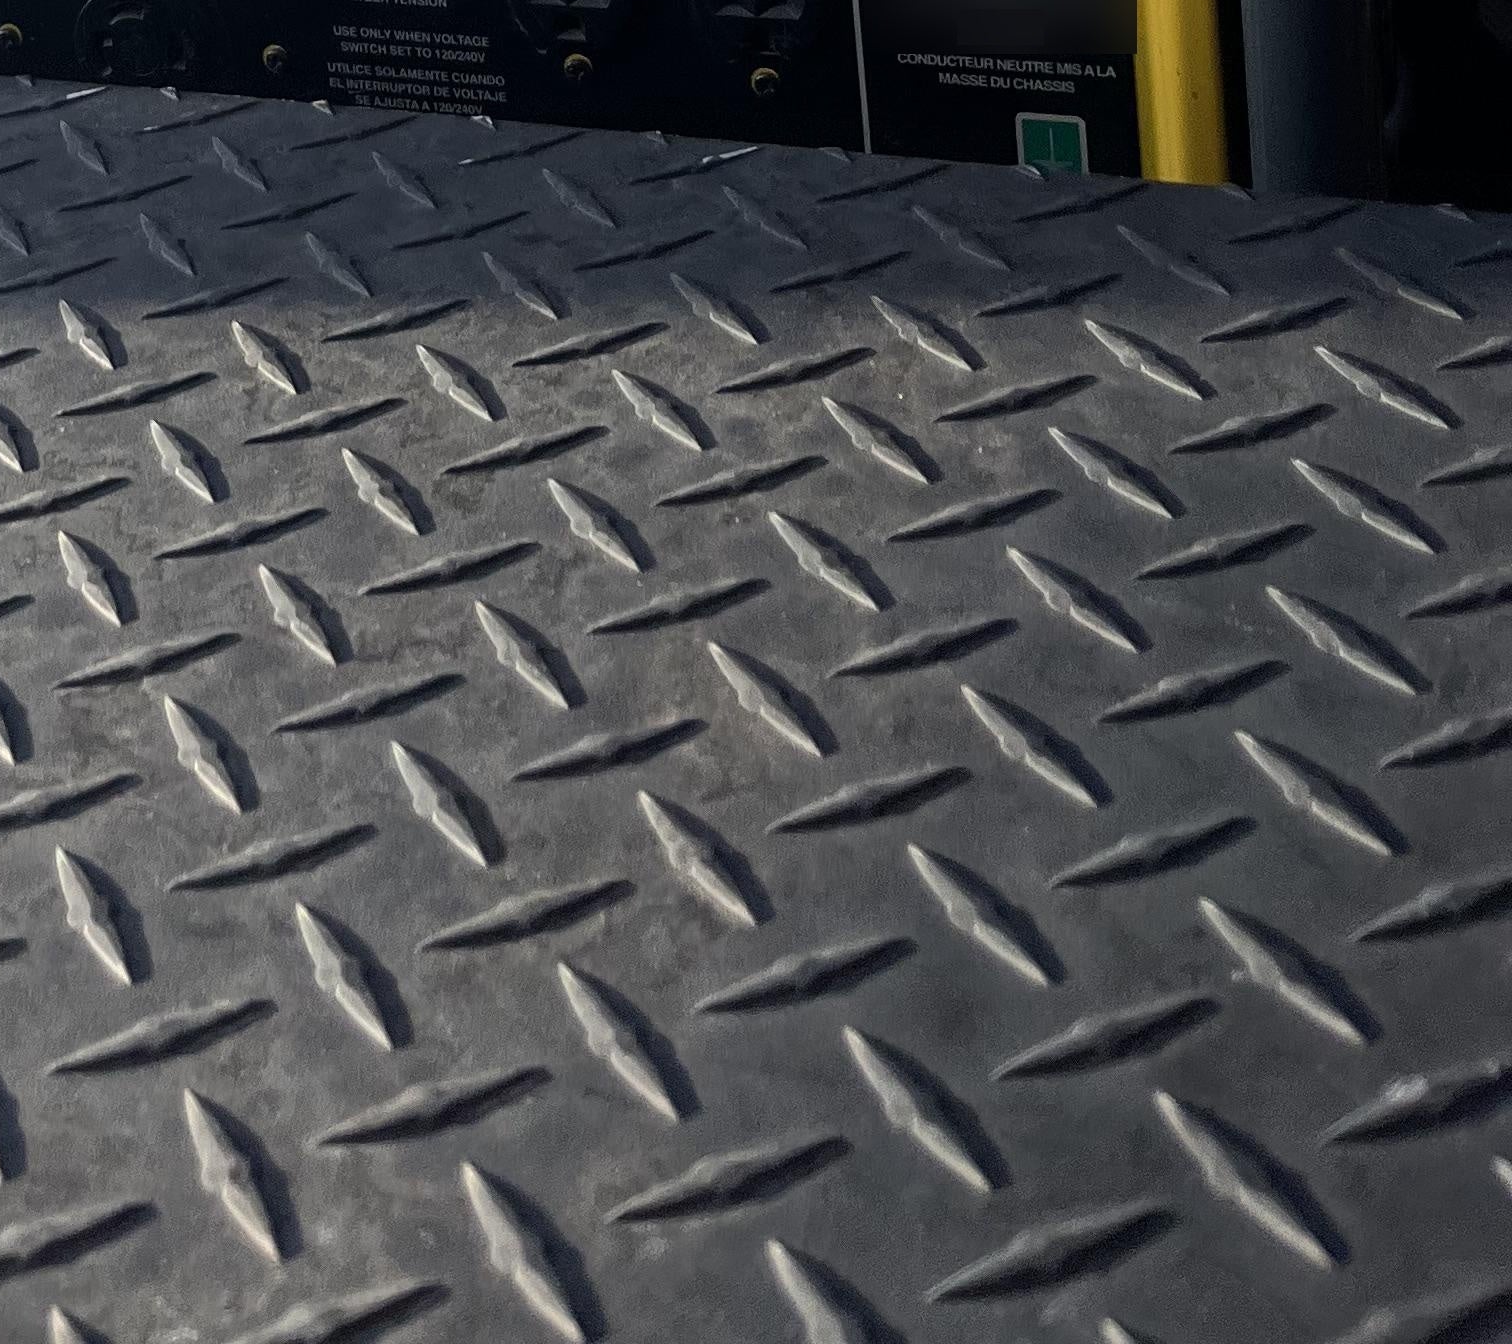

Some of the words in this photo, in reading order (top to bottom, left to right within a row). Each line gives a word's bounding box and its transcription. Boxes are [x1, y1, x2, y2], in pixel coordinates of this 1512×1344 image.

[333, 24, 357, 37] USE
[360, 27, 391, 39] ONLY
[393, 30, 431, 43] WHEN
[433, 32, 490, 47] VOLTAGE
[340, 41, 387, 54] SWITCH
[389, 45, 412, 57] SET
[417, 47, 432, 59] TO
[435, 49, 485, 64] 120/240V
[327, 62, 372, 76] UTILICE
[374, 65, 448, 83] SOLAMENTE
[451, 72, 505, 87] CUANDO
[897, 53, 994, 70] CONDUCTEUR
[997, 58, 1054, 74] NEUTRE
[1056, 62, 1082, 76] MIS
[329, 77, 345, 89] EL
[347, 79, 430, 96] INTERRUPTOR
[433, 86, 449, 98] DE
[452, 87, 508, 103] VOLTAJE
[939, 72, 988, 88] MASSE
[990, 76, 1010, 89] DU
[1013, 78, 1075, 93] CHASSIS
[355, 94, 370, 106] SE
[374, 96, 419, 110] AJUSTA
